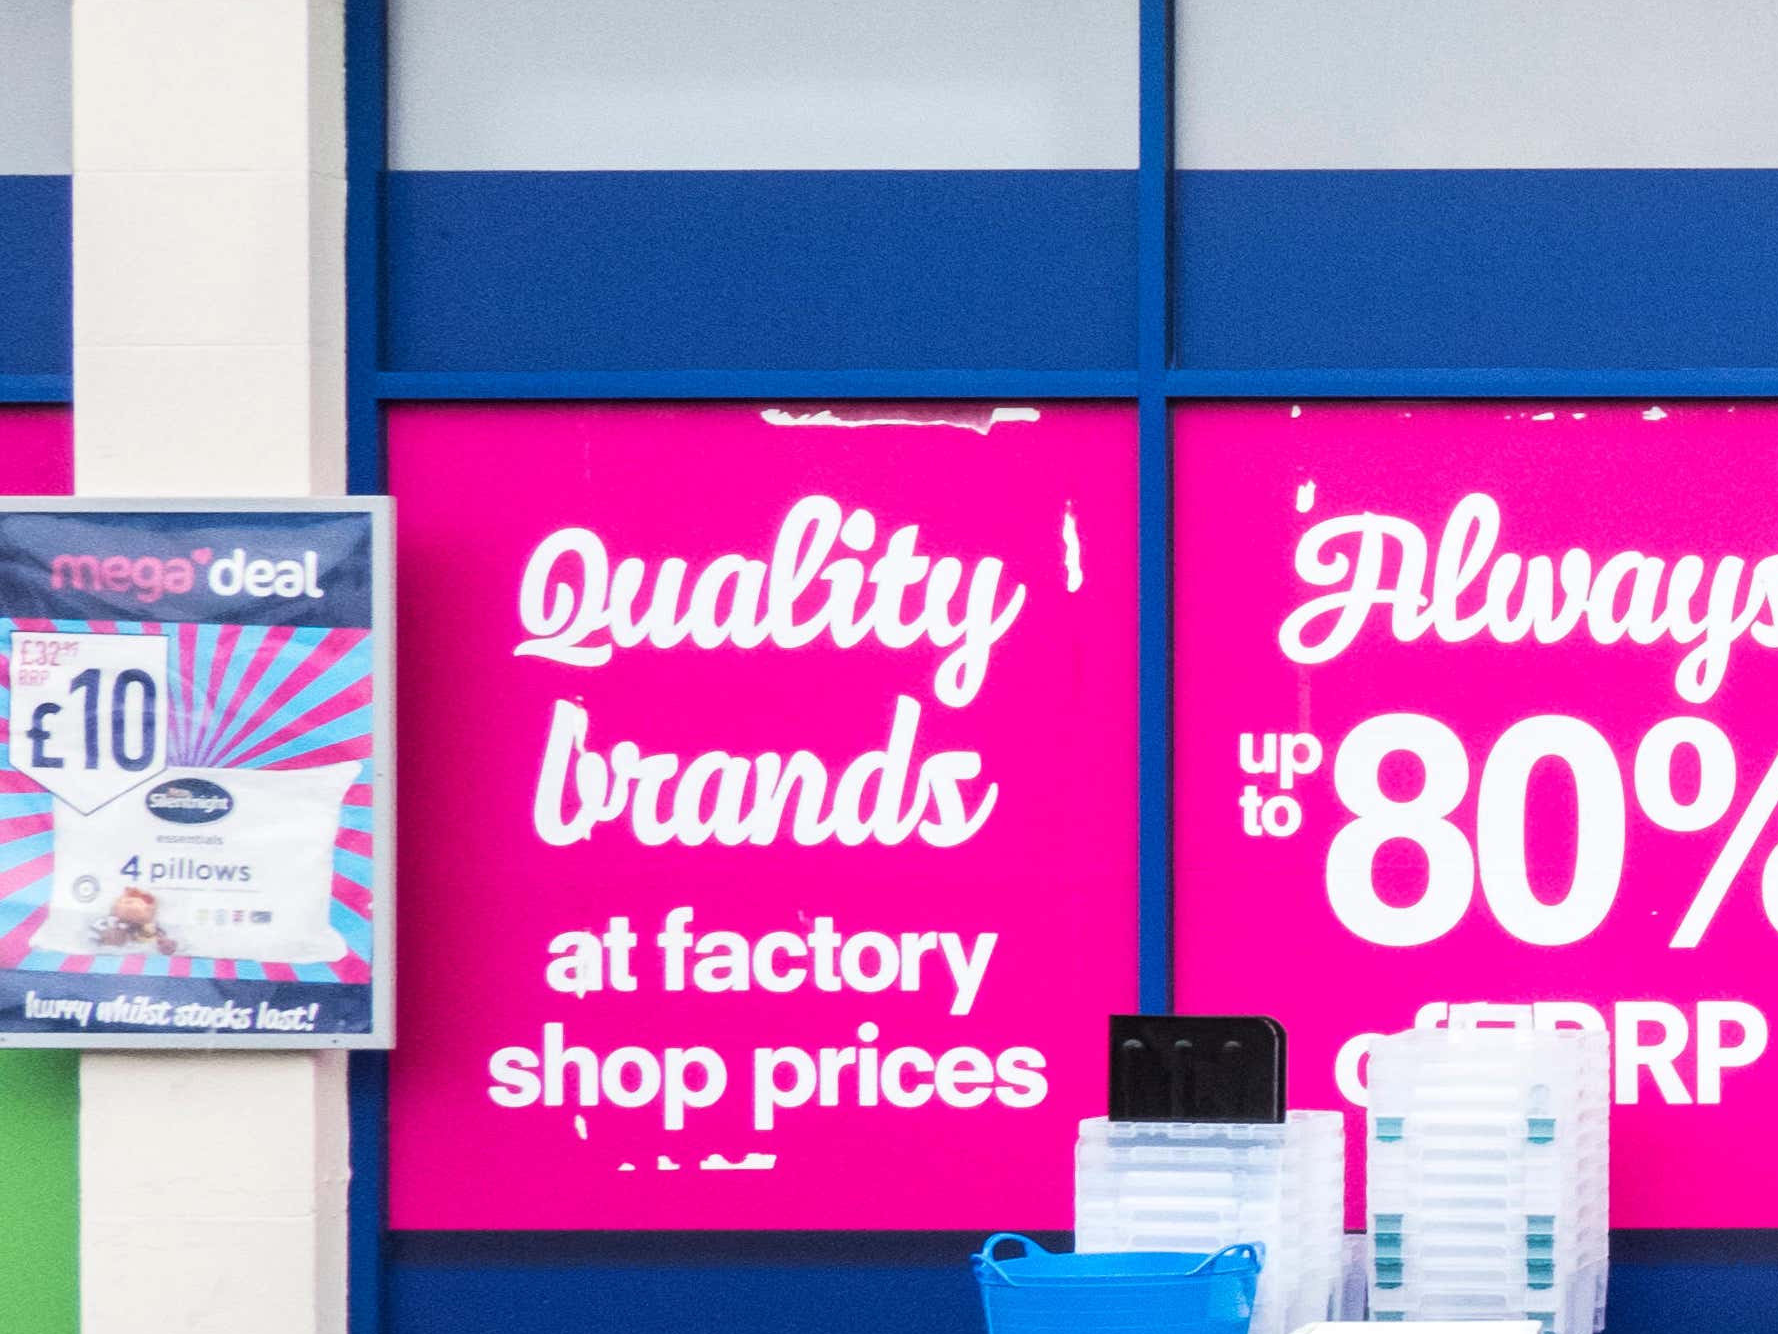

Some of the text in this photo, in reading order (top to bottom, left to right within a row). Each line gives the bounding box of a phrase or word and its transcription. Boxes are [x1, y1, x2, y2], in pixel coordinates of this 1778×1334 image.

[51, 547, 324, 603] mega deal
[513, 494, 1026, 708] Quality
[26, 668, 157, 772] £10
[533, 695, 999, 848] brands
[1239, 732, 1323, 789] up
[1239, 786, 1302, 837] to
[120, 854, 252, 883] 4 pillows
[25, 990, 320, 1032] hurry whilst stocks last!
[546, 906, 998, 1016] at factory
[488, 1021, 1048, 1131] shop prices
[1533, 1000, 1769, 1105] RP
